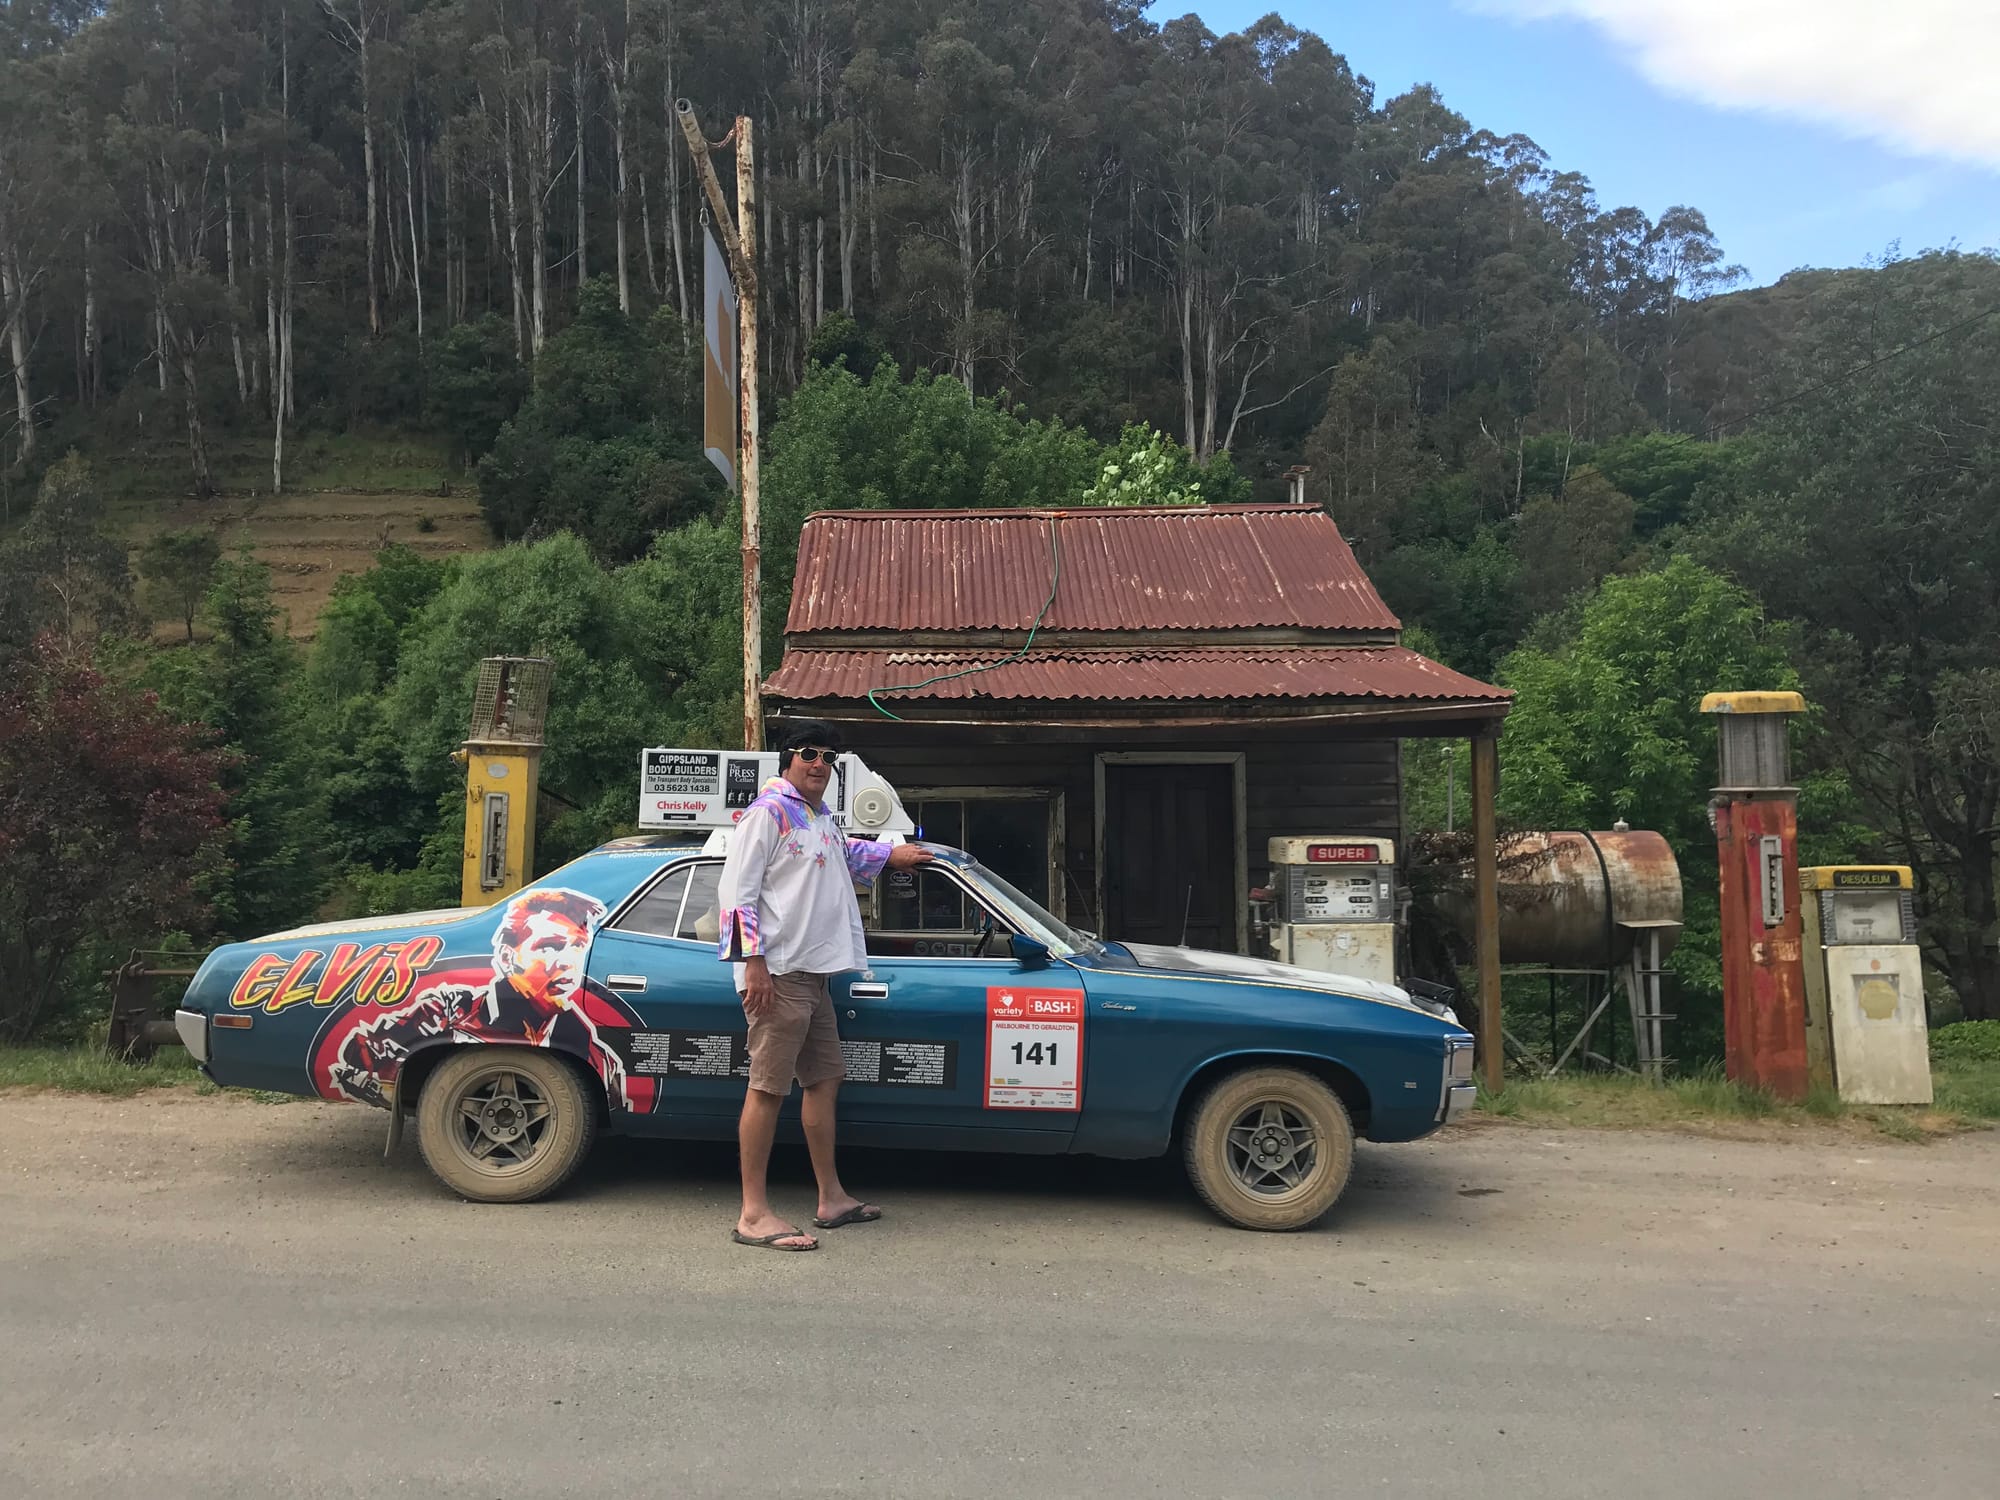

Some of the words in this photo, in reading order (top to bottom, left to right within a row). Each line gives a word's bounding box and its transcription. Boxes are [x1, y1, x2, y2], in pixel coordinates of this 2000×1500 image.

[659, 754, 708, 765] GIPPSLAND
[648, 765, 672, 774] BODY
[674, 765, 717, 776] BUILDERS
[729, 768, 756, 778] PRESS
[647, 775, 656, 783] The
[657, 776, 679, 784] Transport
[680, 776, 691, 785] Body
[692, 776, 717, 785] Specialists
[666, 784, 688, 792] 5623
[690, 785, 710, 793] 1438
[657, 800, 682, 810] Chris
[683, 800, 707, 813] Kelly
[1318, 848, 1365, 859] SUPER
[1840, 874, 1890, 885] DIESOLEUM
[993, 1007, 1023, 1016] variety
[1034, 1001, 1071, 1013] BASH
[1011, 1042, 1057, 1065] 141
